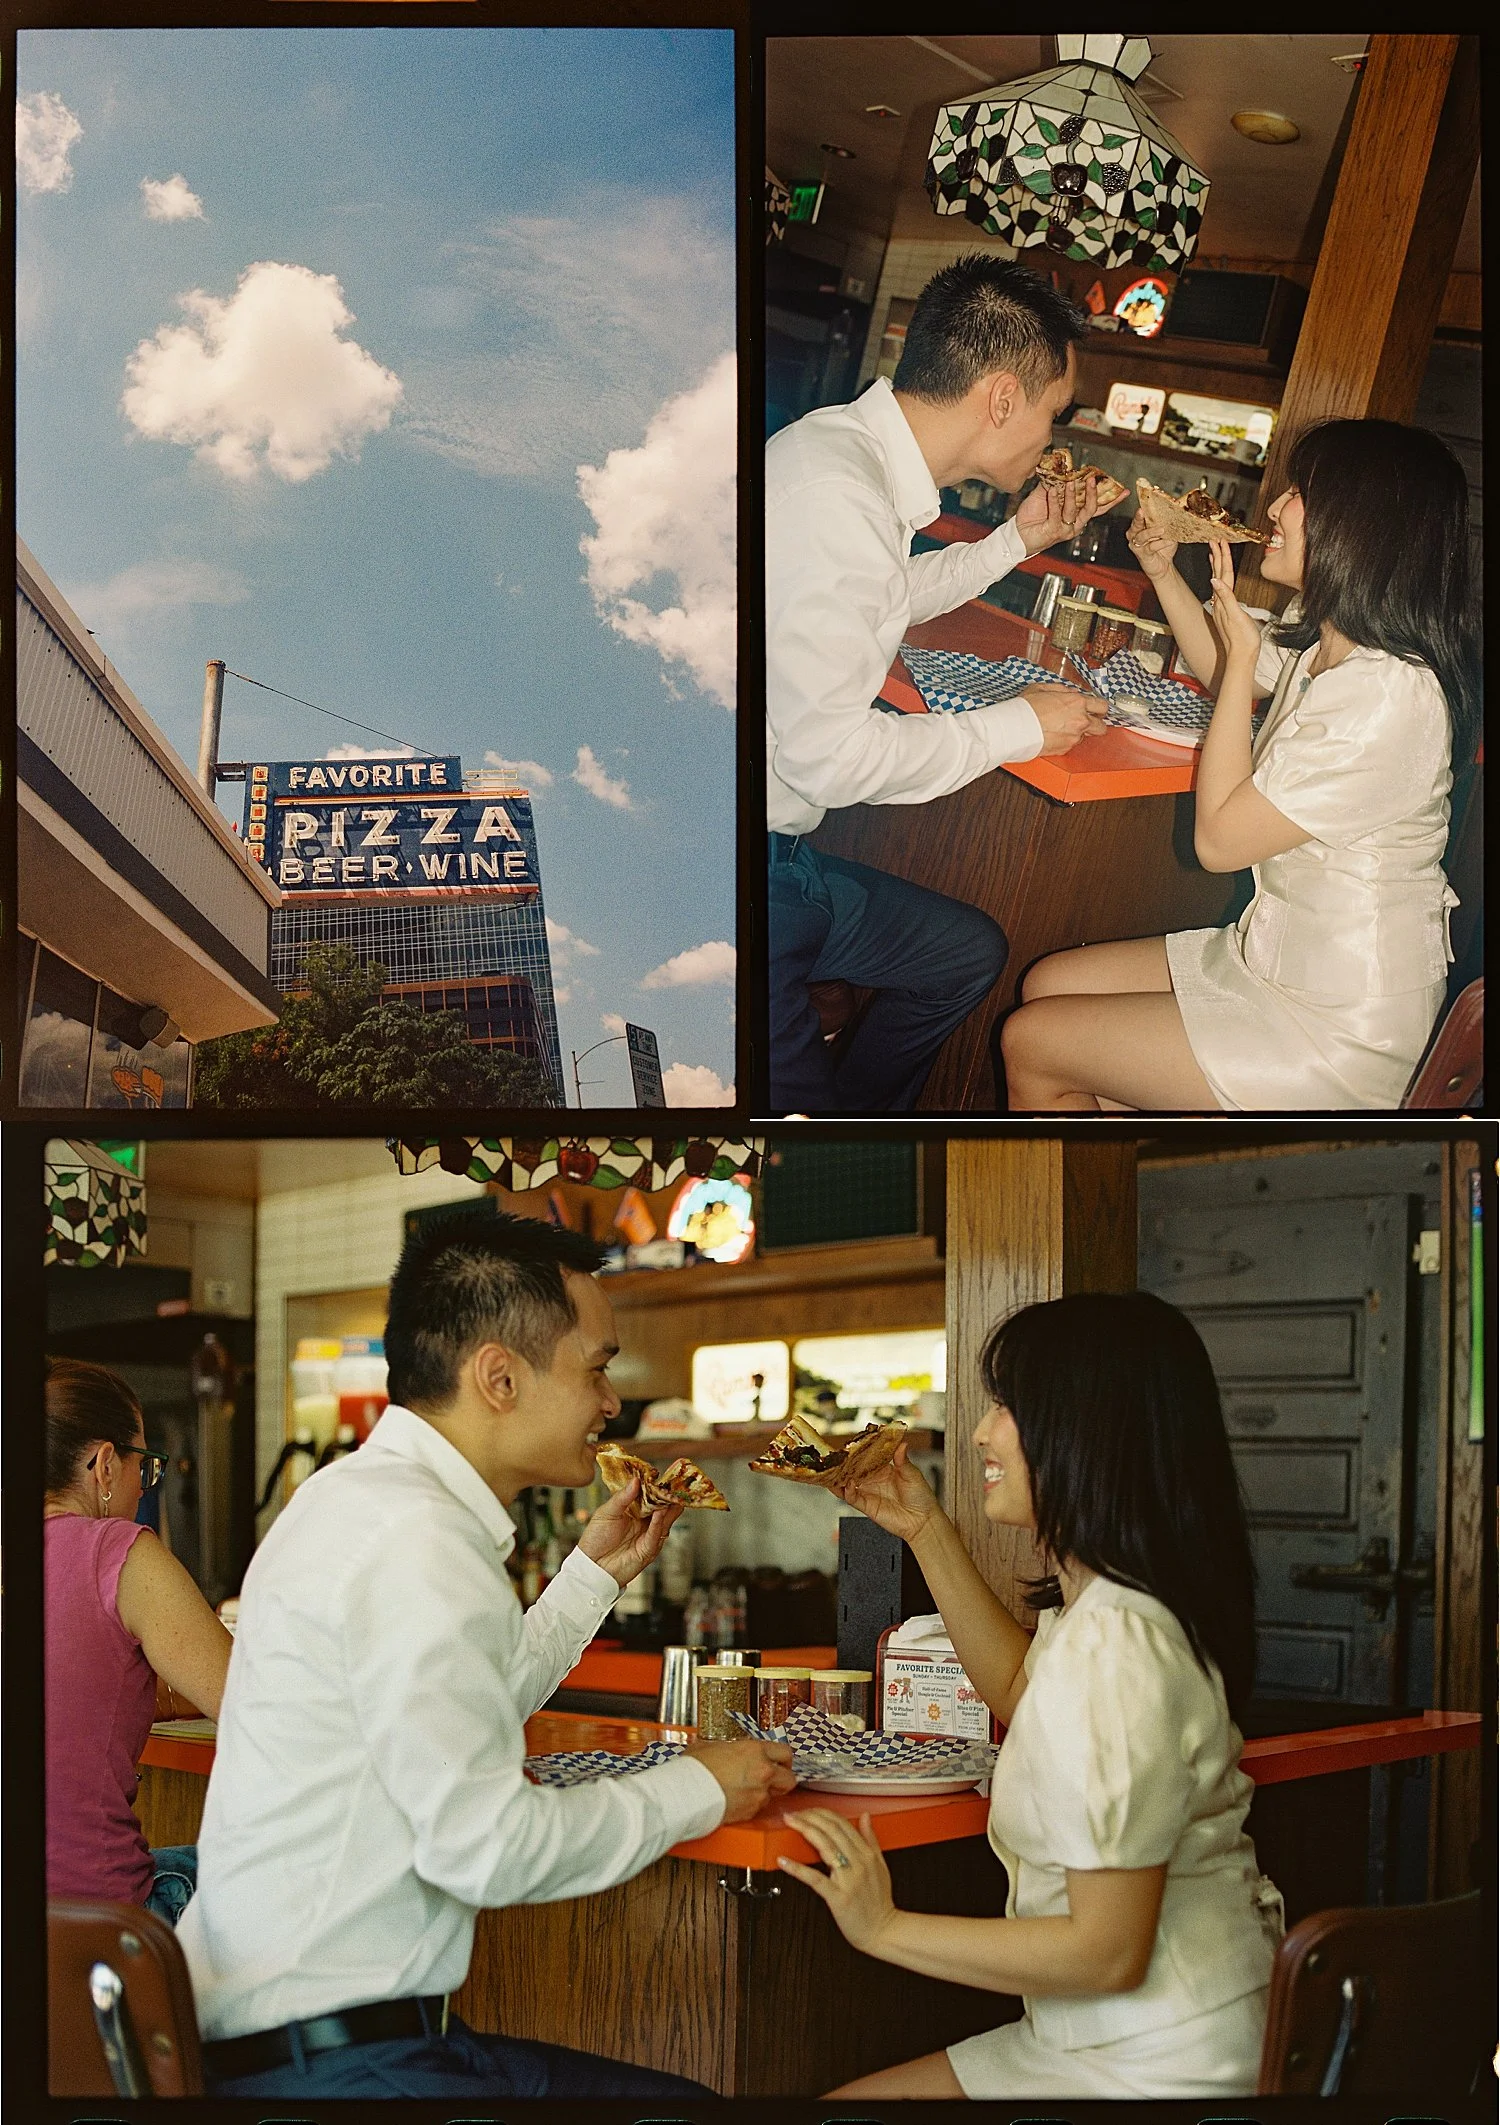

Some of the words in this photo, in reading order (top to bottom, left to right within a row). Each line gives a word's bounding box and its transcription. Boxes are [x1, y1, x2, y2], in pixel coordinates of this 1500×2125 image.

[289, 763, 447, 788] FAVORITE
[284, 806, 521, 849] PIZZA
[279, 855, 399, 885] BEER
[419, 851, 529, 880] WINE
[632, 1056, 658, 1072] CUSTOMER
[896, 1664, 934, 1673] FAVORITE
